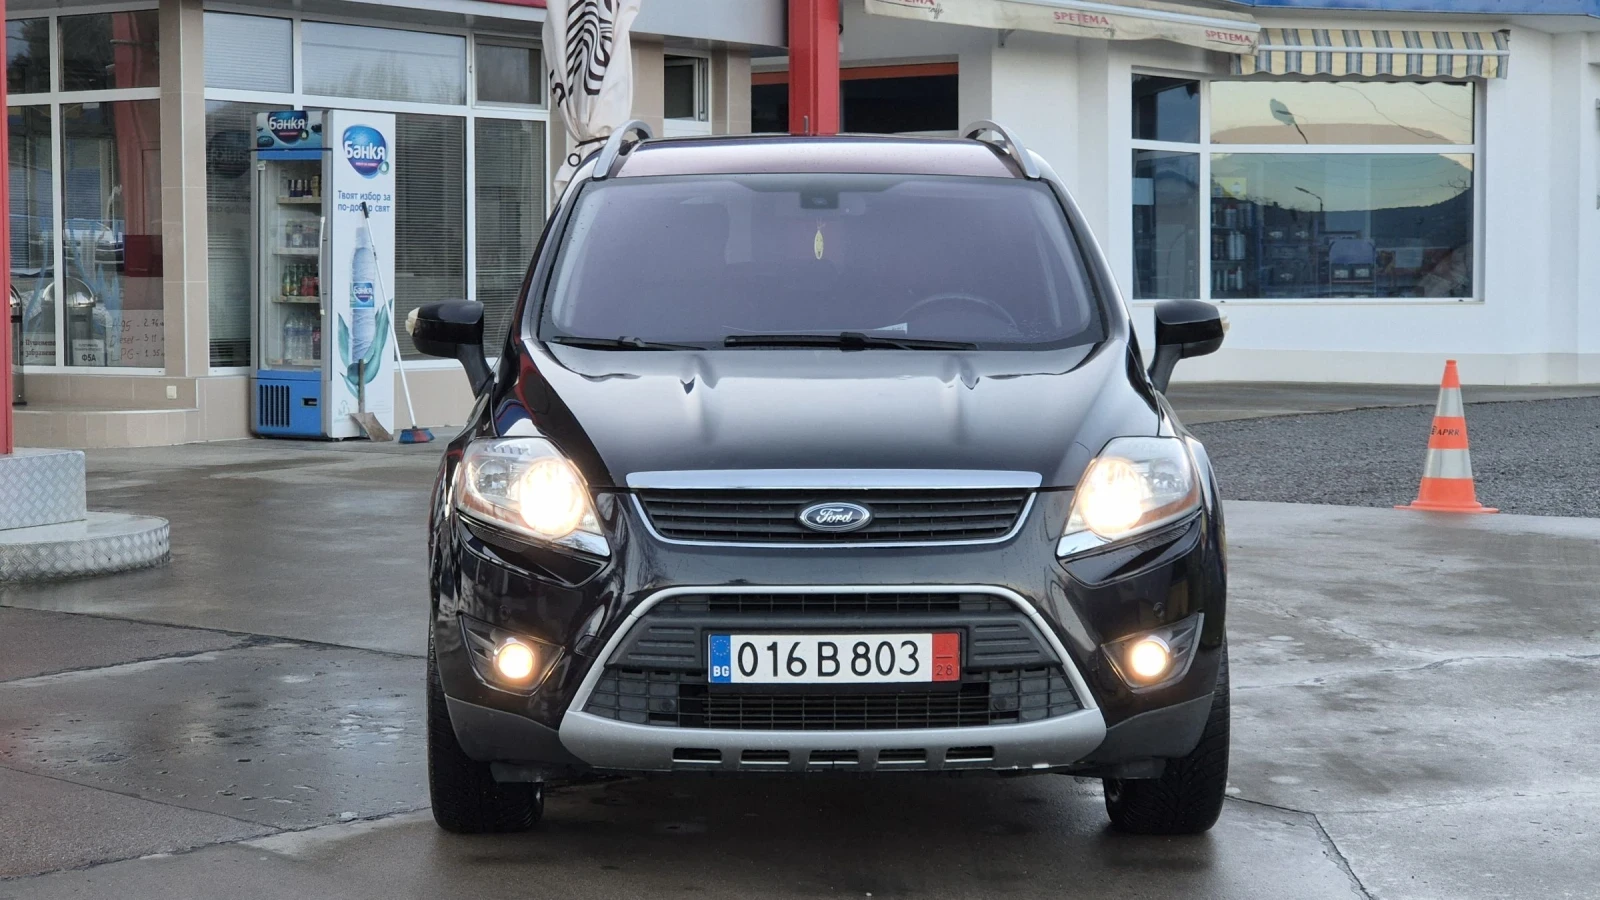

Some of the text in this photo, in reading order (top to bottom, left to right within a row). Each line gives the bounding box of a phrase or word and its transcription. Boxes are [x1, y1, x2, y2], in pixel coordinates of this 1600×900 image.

[1053, 11, 1109, 25] SPETEMA
[1205, 29, 1252, 43] SPETEMA
[337, 190, 358, 200] Твоят
[360, 191, 381, 203] избор
[337, 203, 373, 213] по-добр
[111, 347, 134, 361] LPG
[1437, 428, 1460, 436] APRR
[816, 508, 853, 523] Ford
[737, 640, 920, 677] 016 B 803
[713, 665, 730, 677] BG
[936, 664, 953, 676] 28
